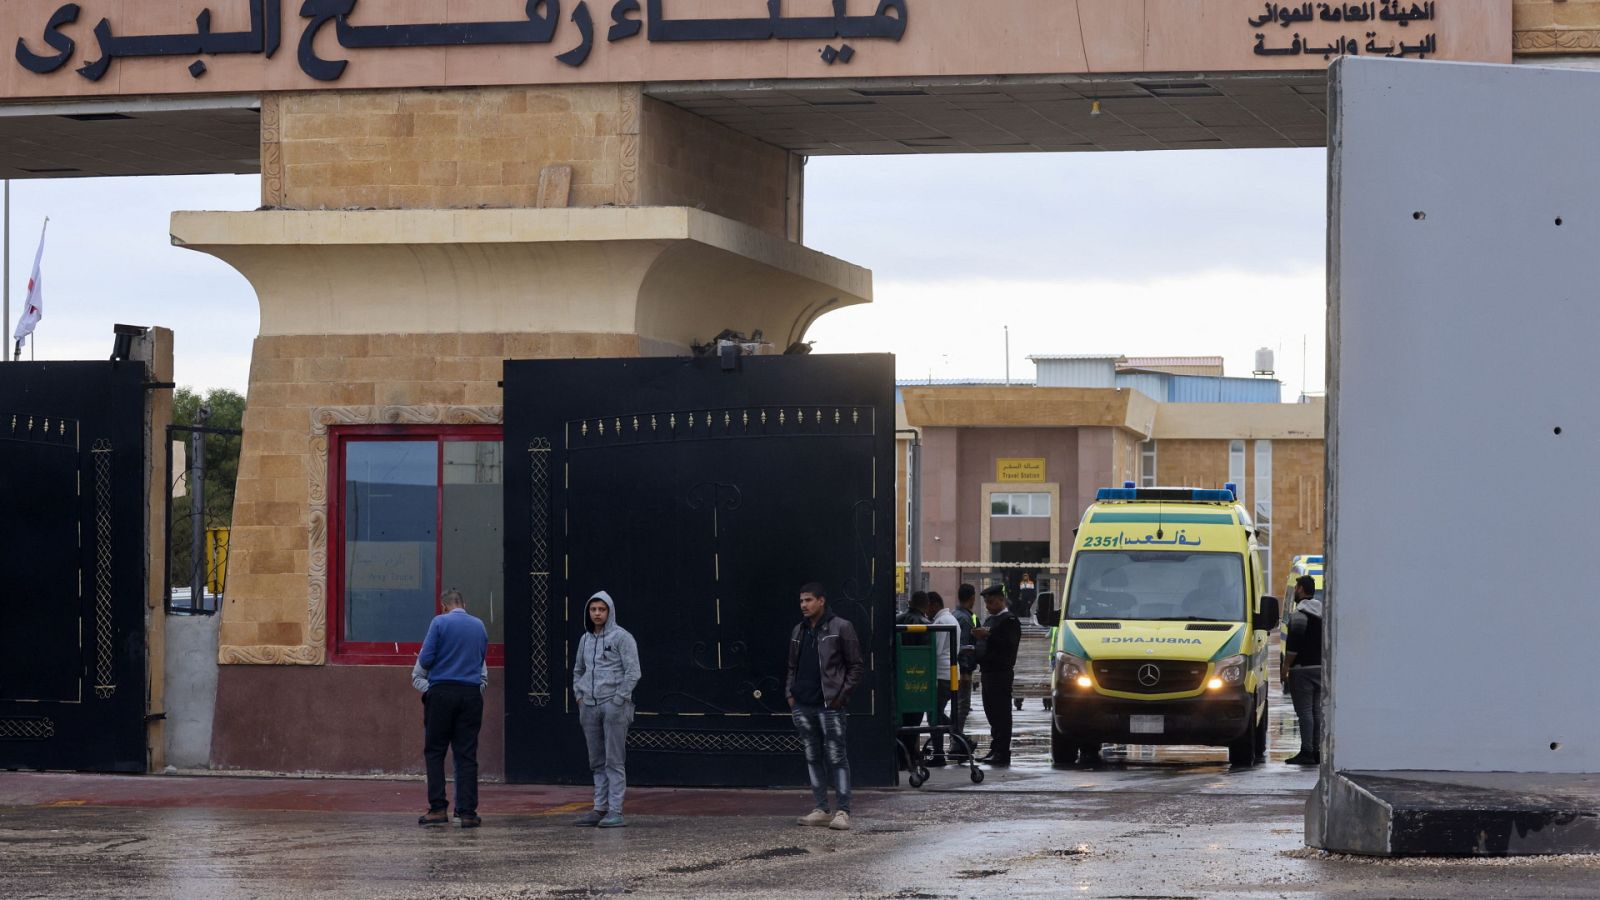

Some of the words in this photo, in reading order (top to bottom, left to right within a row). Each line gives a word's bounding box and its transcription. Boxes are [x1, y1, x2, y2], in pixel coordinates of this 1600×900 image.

[1317, 2, 1375, 22] العامة
[1379, 0, 1435, 27] الهيئة
[1253, 33, 1358, 59] والجافة
[1366, 31, 1436, 59] البرية
[1083, 535, 1119, 548] 2351
